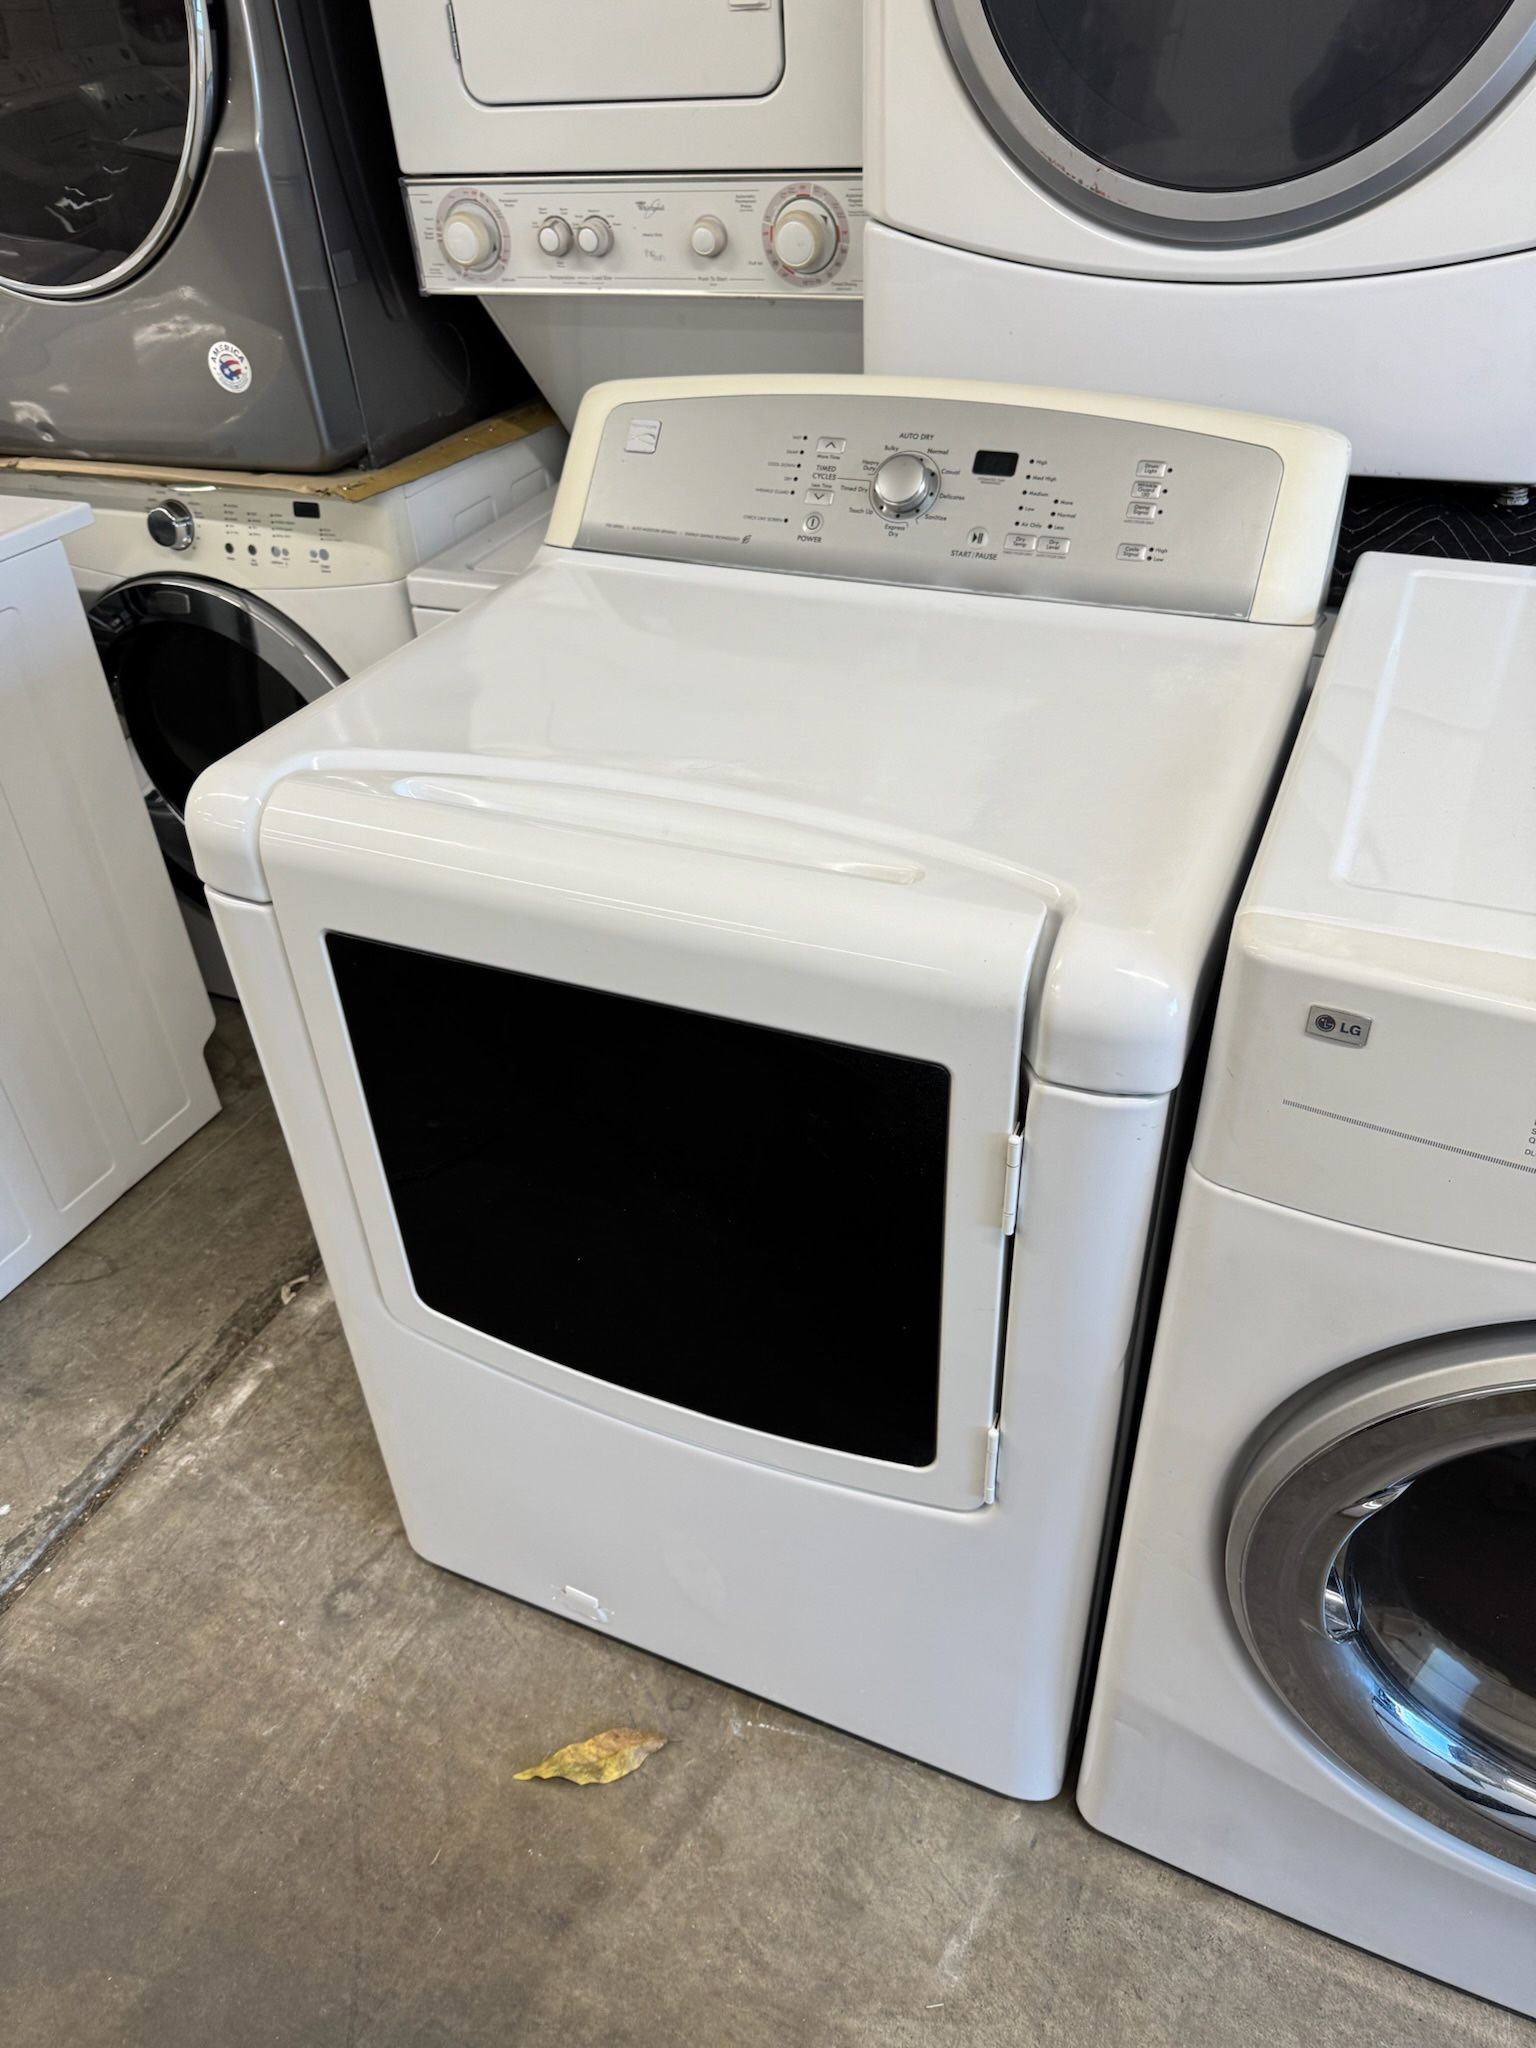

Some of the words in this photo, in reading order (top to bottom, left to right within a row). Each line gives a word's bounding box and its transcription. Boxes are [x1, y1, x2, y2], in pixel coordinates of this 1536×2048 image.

[211, 344, 244, 363] AMERICA
[812, 473, 837, 481] CYCLES
[797, 535, 822, 543] POWER
[950, 550, 972, 558] START
[974, 551, 998, 561] PAUSE
[1340, 1022, 1362, 1036] LG
